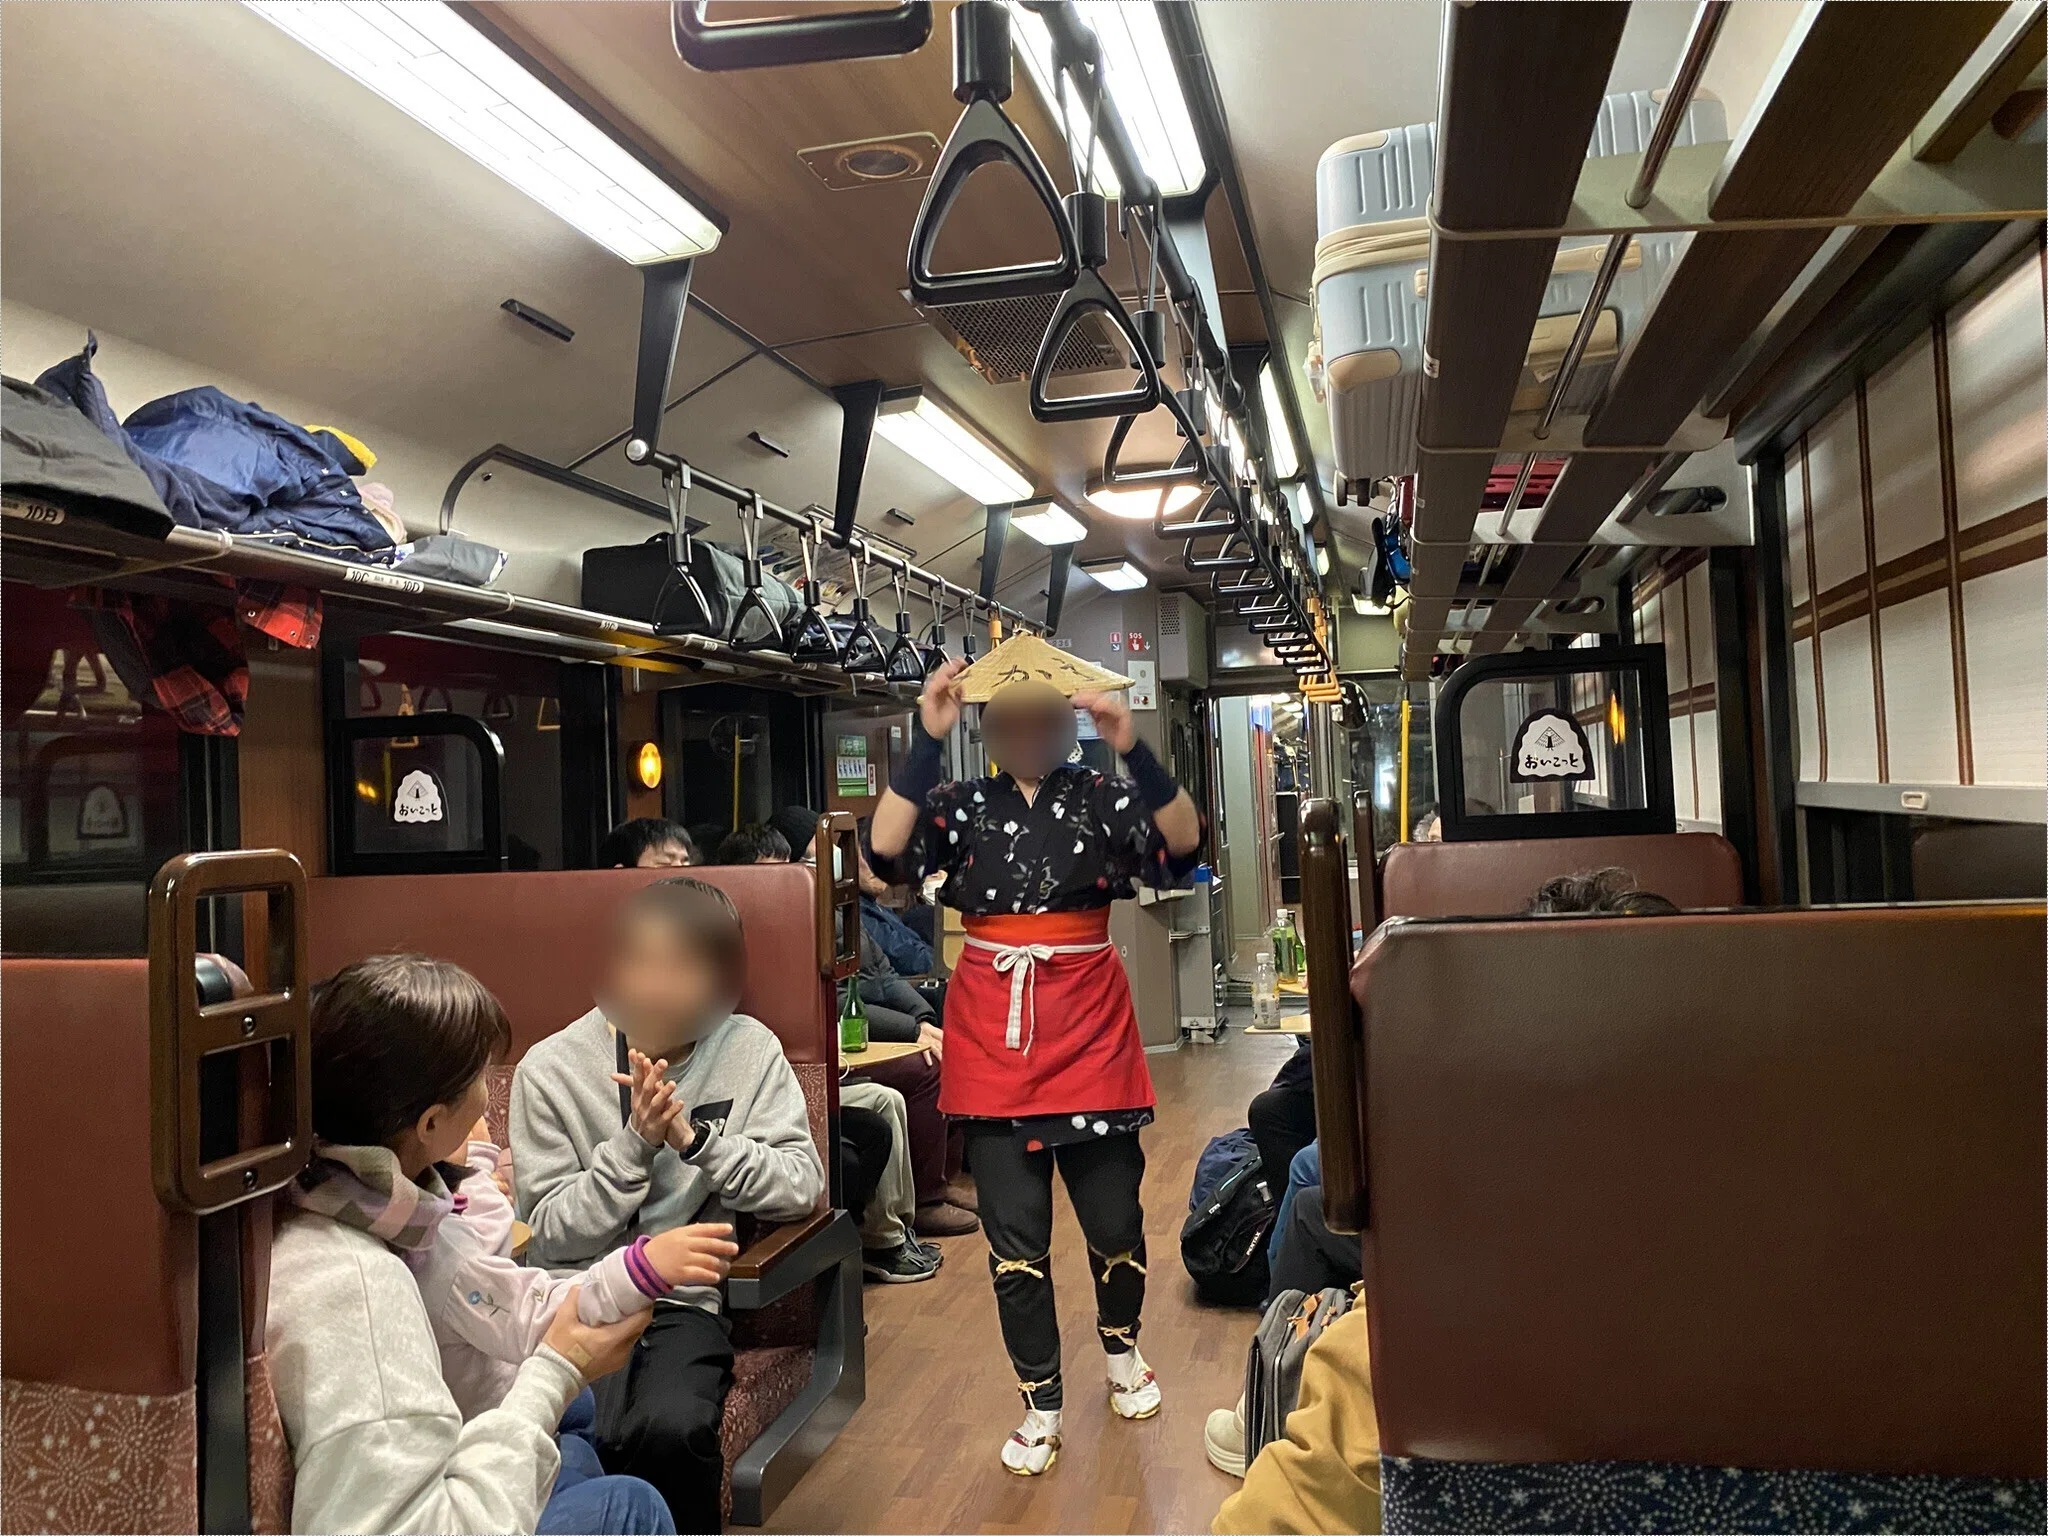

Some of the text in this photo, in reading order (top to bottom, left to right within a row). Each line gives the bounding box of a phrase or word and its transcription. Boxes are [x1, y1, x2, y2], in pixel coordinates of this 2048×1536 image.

[351, 570, 369, 583] 10C
[402, 581, 420, 592] 10D
[1524, 752, 1579, 770] おいこっと
[399, 803, 438, 817] おいこっと
[1246, 1231, 1261, 1256] PENTAX
